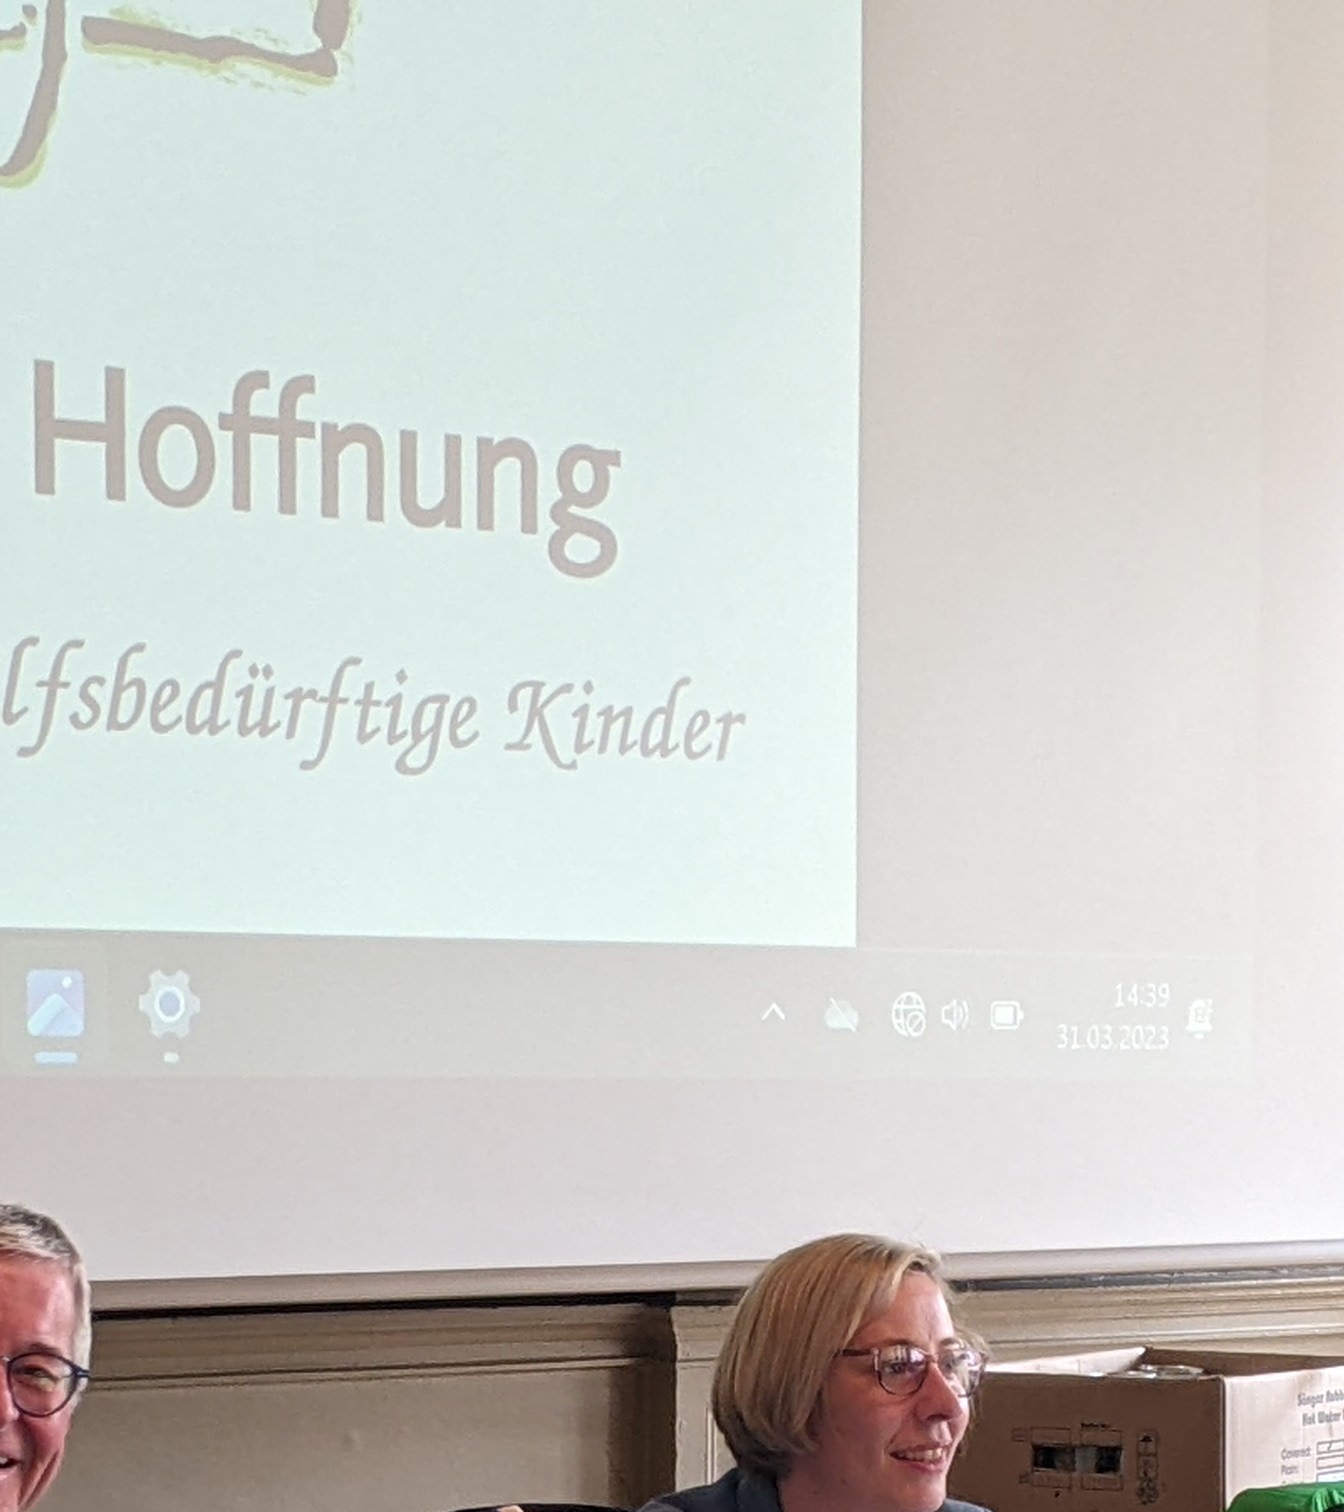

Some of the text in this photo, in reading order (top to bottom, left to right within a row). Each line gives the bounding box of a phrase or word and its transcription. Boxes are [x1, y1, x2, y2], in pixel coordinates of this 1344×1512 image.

[33, 358, 622, 580] Hoffnung
[503, 676, 746, 771] Kinder
[1056, 1023, 1170, 1050] 31.03.2023
